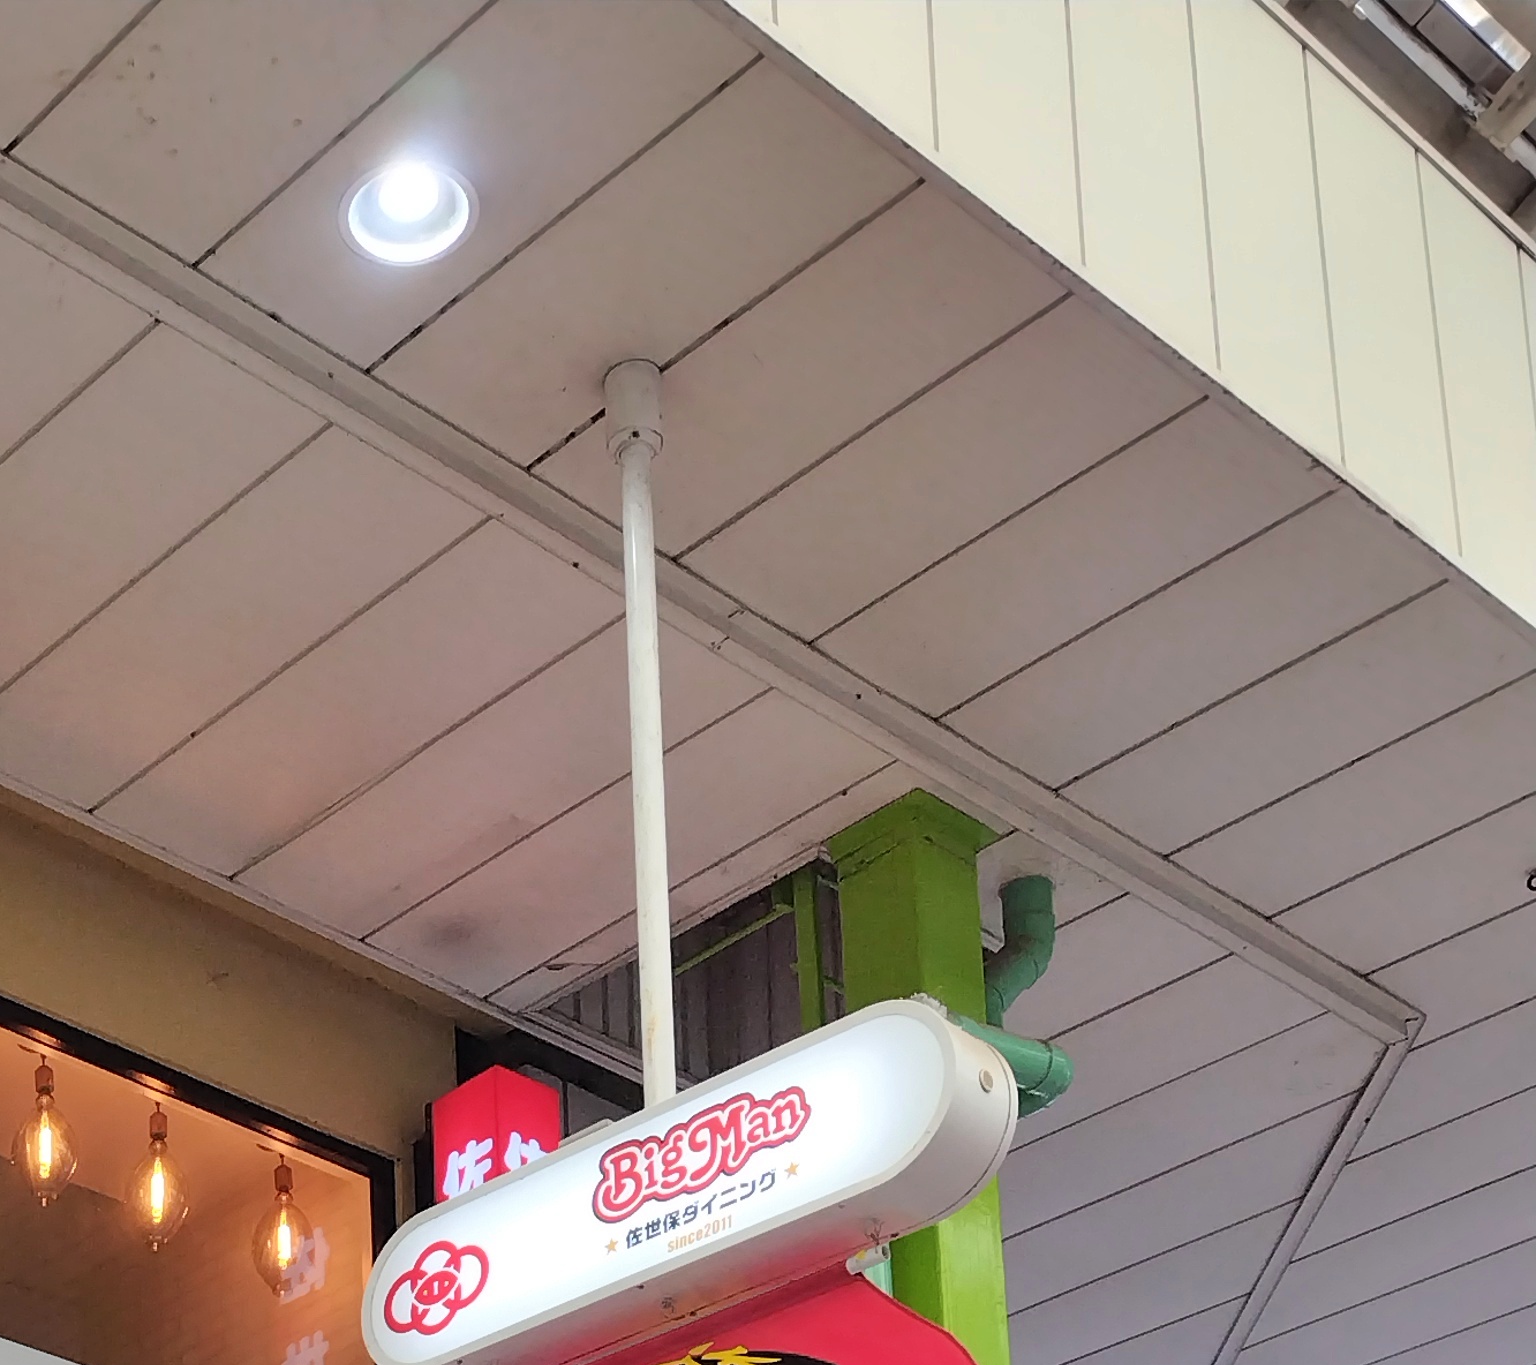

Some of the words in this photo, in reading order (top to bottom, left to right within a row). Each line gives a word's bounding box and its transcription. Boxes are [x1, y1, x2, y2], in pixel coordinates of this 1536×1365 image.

[625, 1168, 777, 1249] 佐世保ダイニング
